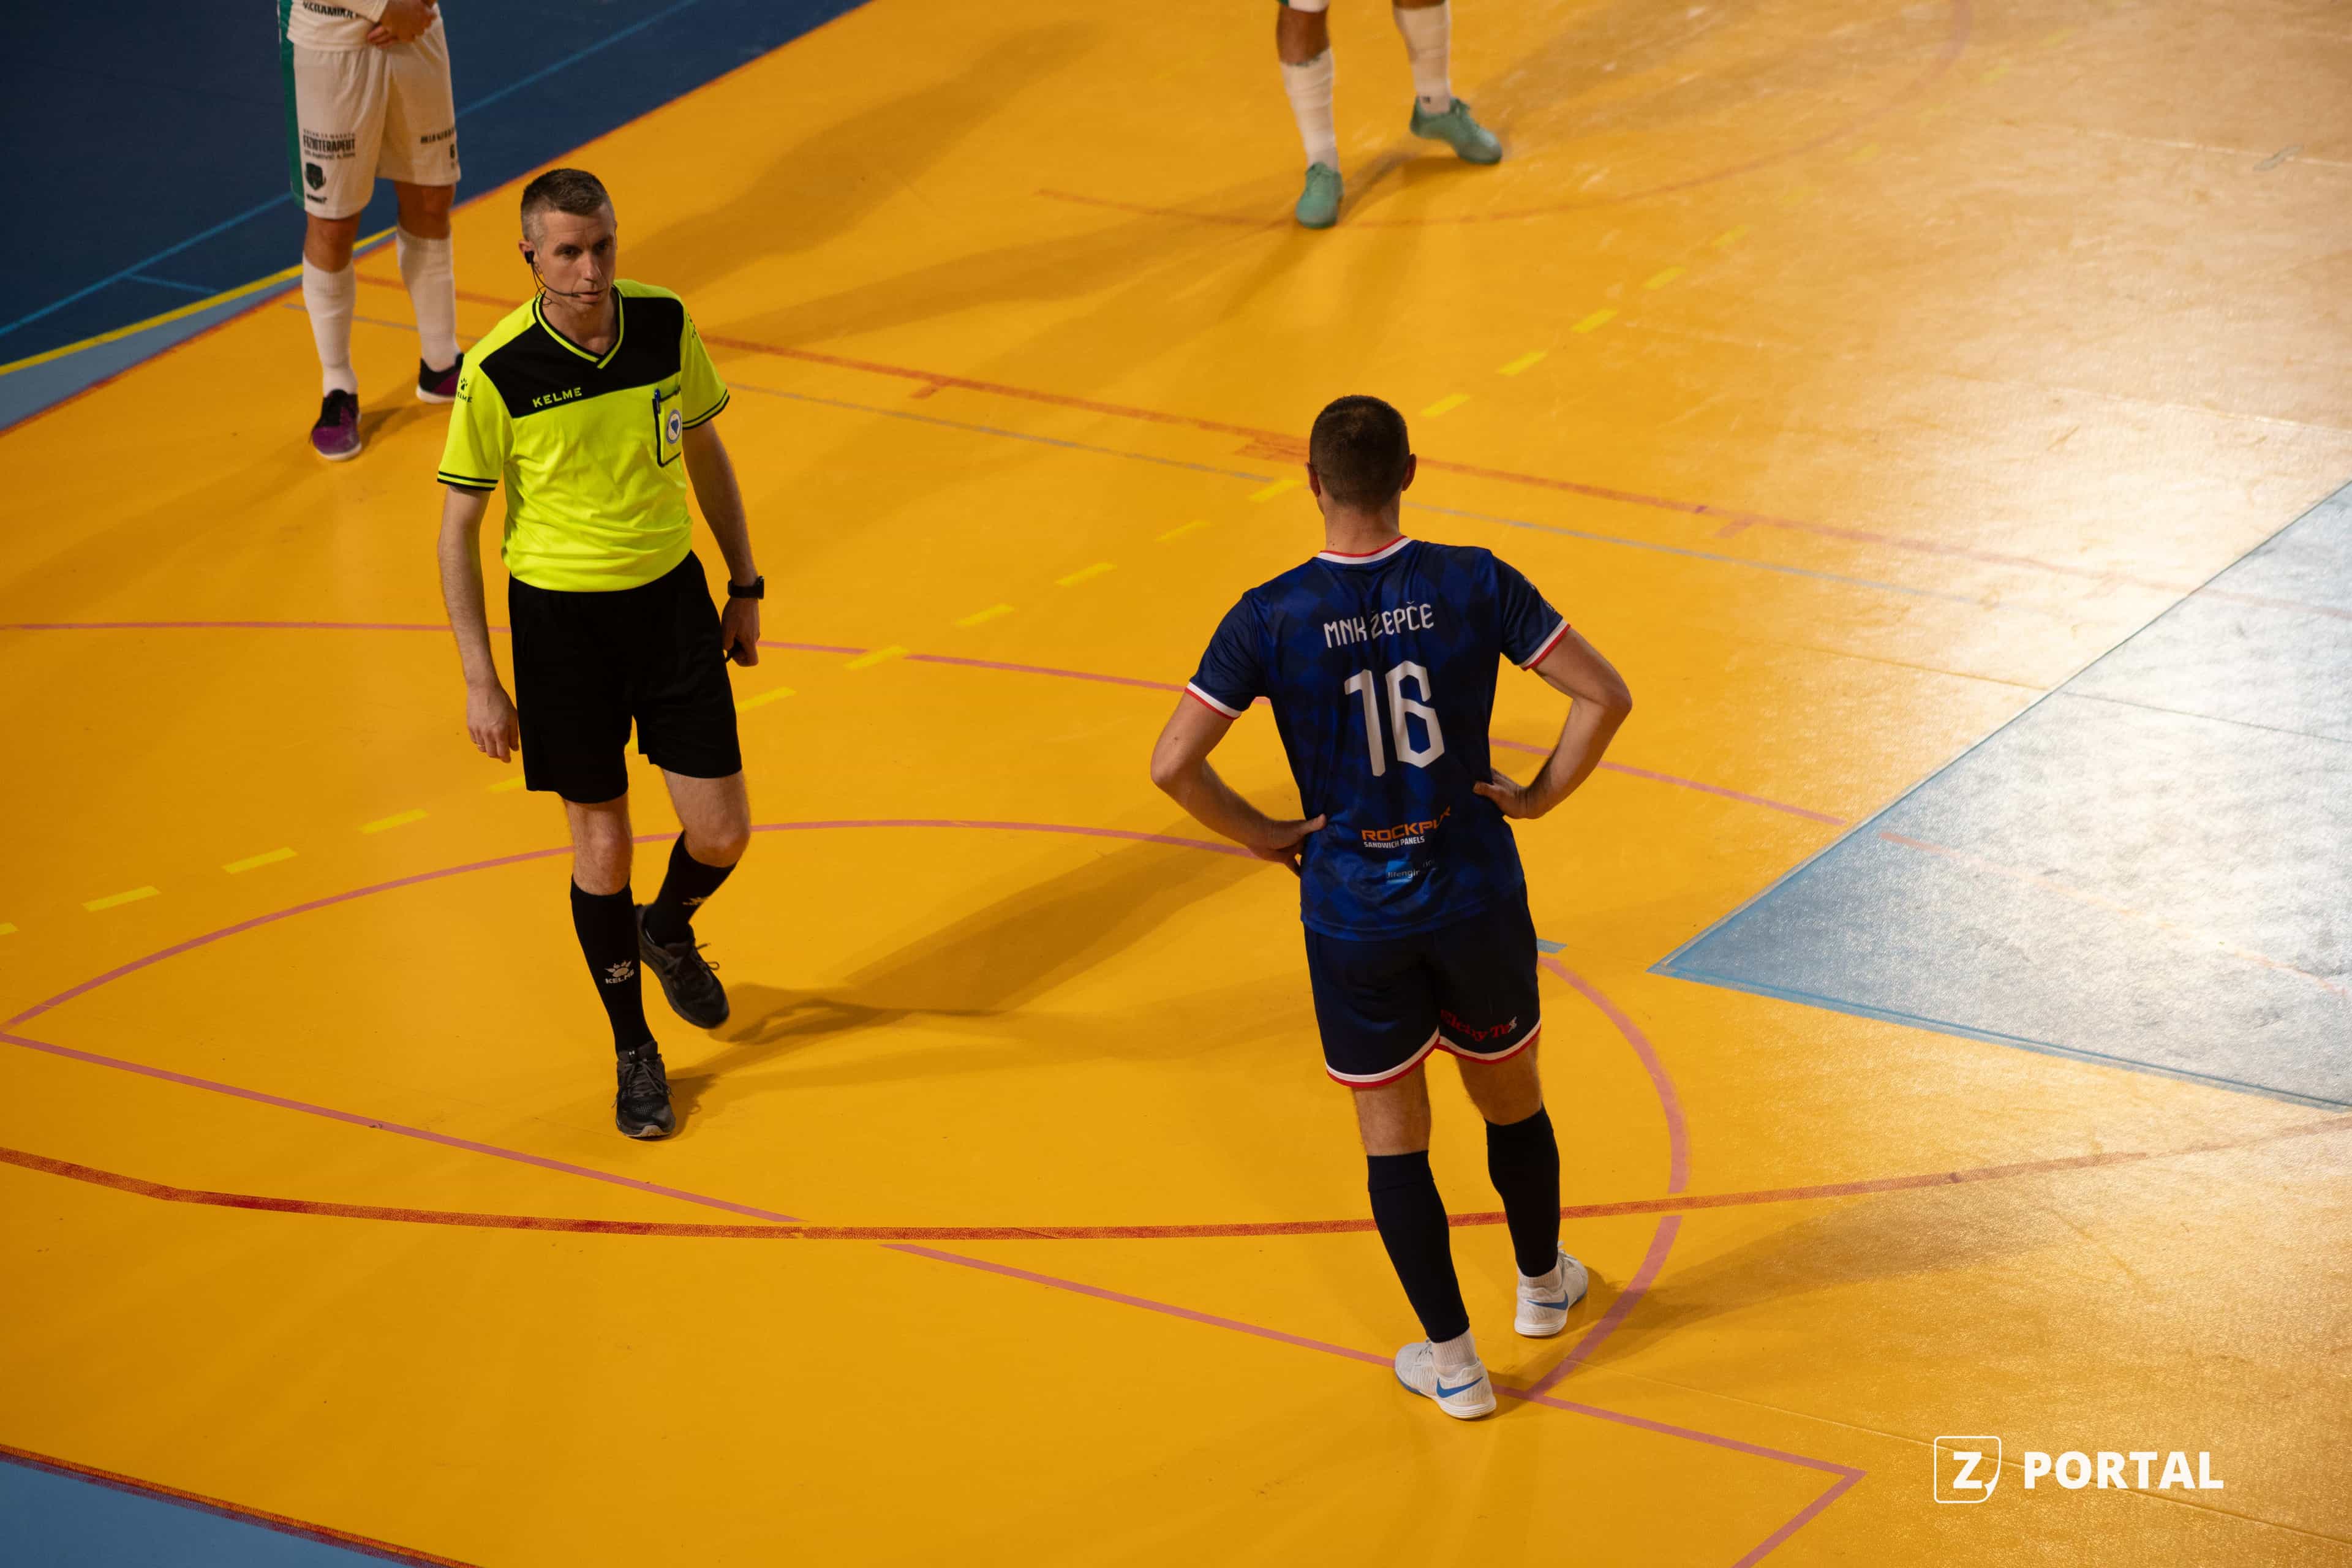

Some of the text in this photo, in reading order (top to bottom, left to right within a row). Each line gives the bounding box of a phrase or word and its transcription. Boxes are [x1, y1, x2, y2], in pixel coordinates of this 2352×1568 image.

[532, 387, 582, 408] KELME
[1323, 616, 1368, 649] MNK
[1344, 660, 1445, 777] 16
[1363, 835, 1425, 849] SANDWICH PANELS
